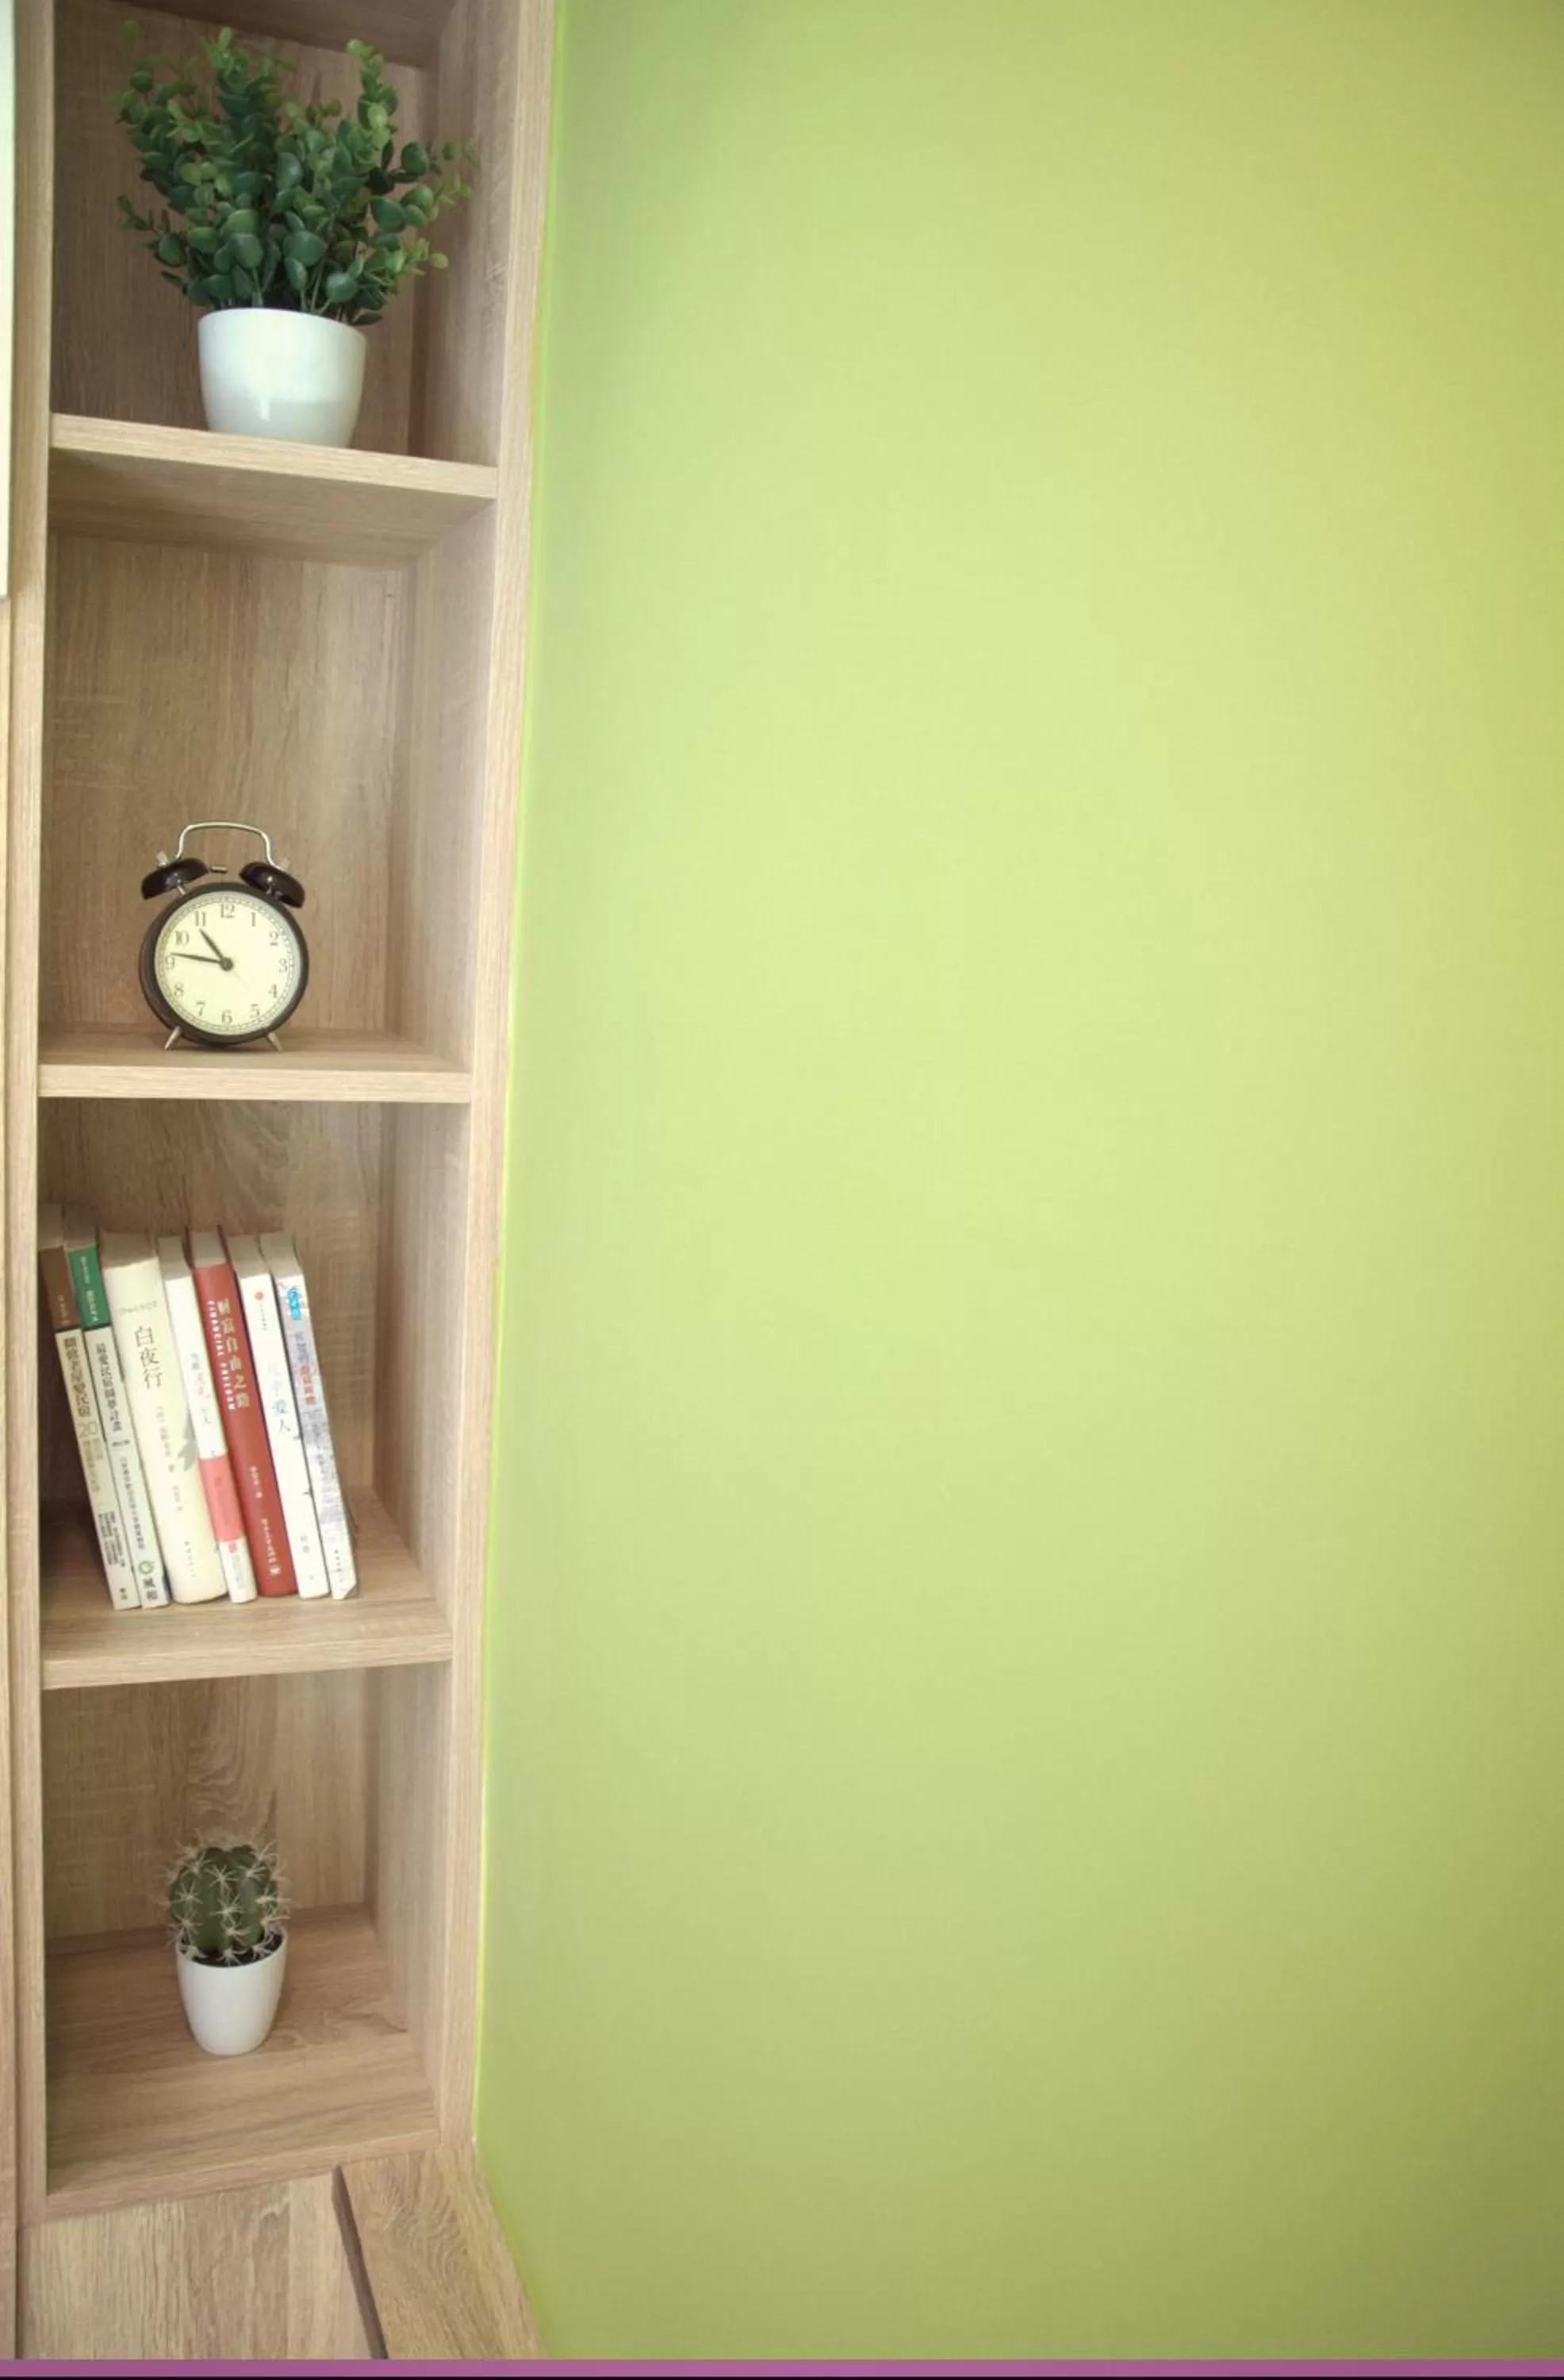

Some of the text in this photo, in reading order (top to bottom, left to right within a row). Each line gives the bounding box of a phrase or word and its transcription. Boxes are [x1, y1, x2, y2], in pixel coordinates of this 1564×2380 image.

[195, 911, 206, 927] 11
[220, 904, 236, 919] 12
[251, 912, 256, 927] 1
[174, 931, 190, 945] 10
[270, 931, 279, 946] 2
[165, 954, 175, 970] 9
[279, 958, 288, 973] 3
[174, 983, 184, 997] 8
[268, 984, 278, 998] 4
[197, 1001, 206, 1016] 7
[250, 1004, 260, 1019] 5
[221, 1009, 232, 1025] 6
[134, 1326, 163, 1390] 白夜行
